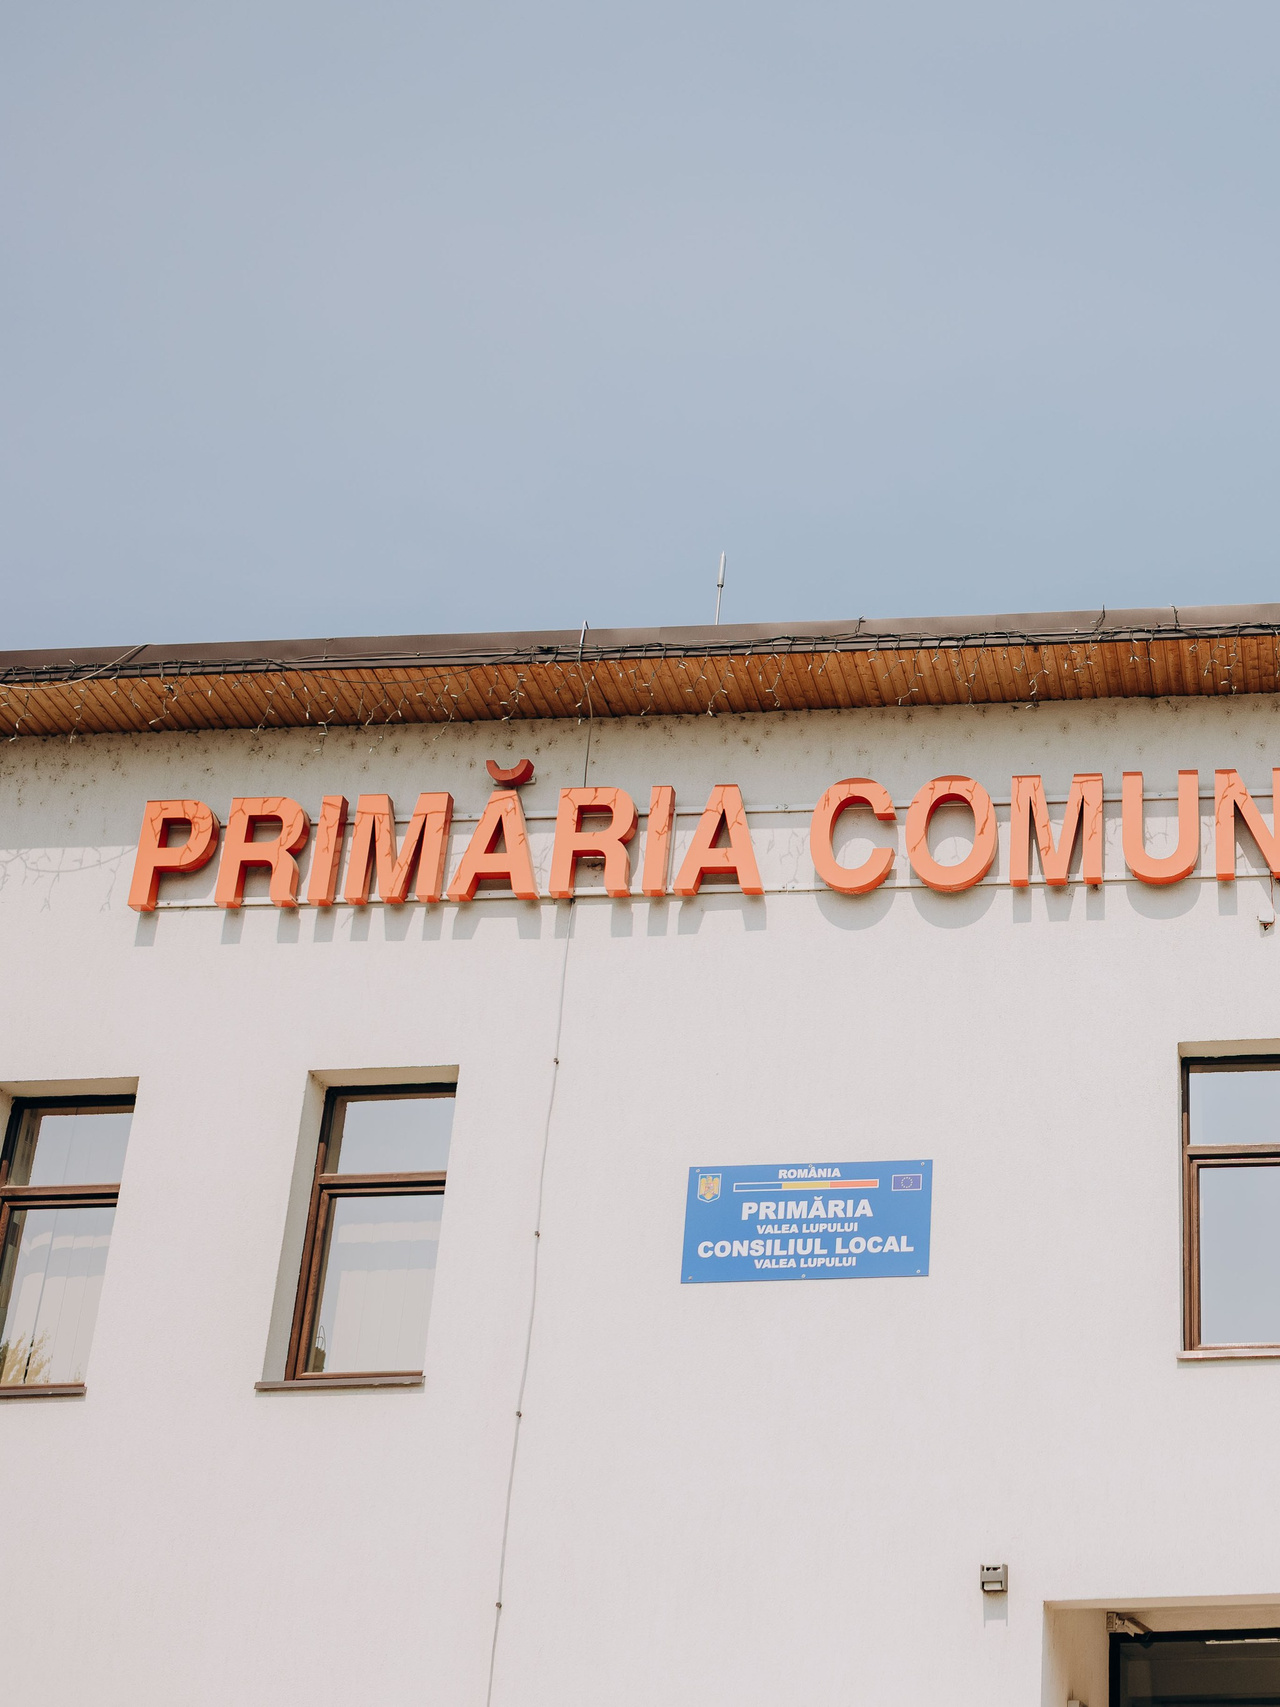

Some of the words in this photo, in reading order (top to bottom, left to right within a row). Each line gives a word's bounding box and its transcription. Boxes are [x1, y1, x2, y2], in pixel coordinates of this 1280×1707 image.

[128, 759, 765, 912] PRIMĂRIA
[778, 1167, 842, 1180] ROMÂNIA
[741, 1195, 874, 1221] PRIMĂRIA
[756, 1223, 799, 1235] VALEA
[801, 1221, 859, 1234] LUPULUI
[697, 1237, 828, 1258] CONSILIUL
[834, 1235, 915, 1255] LOCAL
[753, 1257, 797, 1269] VALEA
[799, 1256, 857, 1269] LUPULUI
